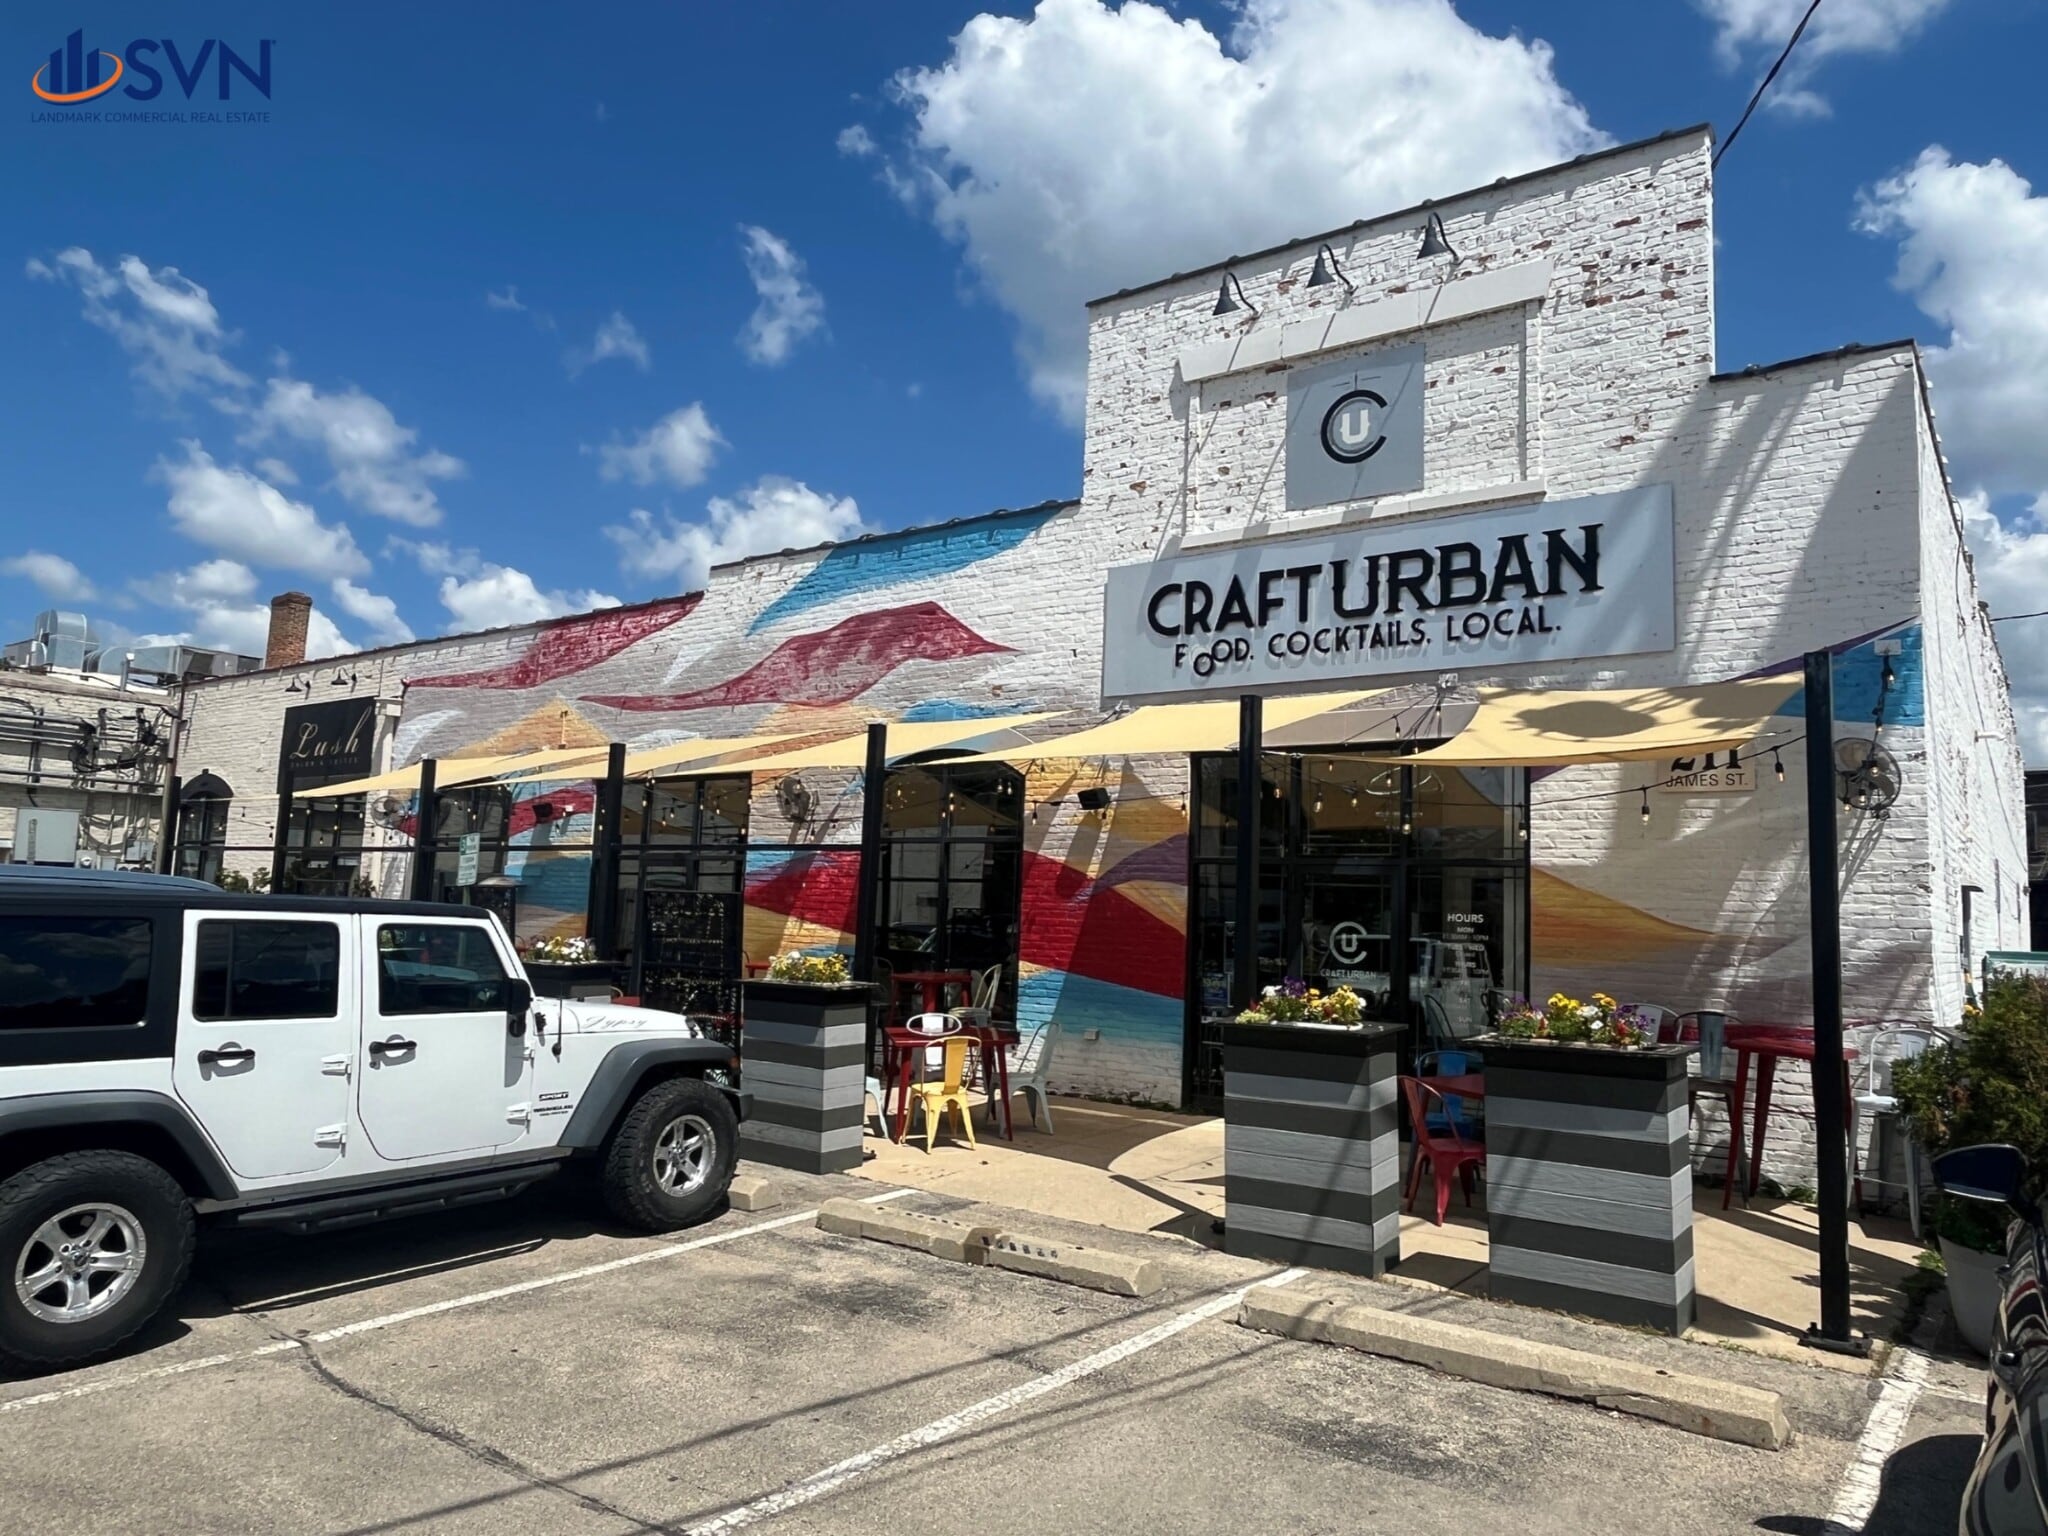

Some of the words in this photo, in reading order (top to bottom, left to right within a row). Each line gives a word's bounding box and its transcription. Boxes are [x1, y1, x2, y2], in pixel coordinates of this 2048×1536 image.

[1174, 637, 1255, 677] FOOD.
[1268, 617, 1432, 659] COCKTAILS.
[1447, 605, 1562, 642] LOCAL.
[290, 706, 372, 760] Lush
[1666, 773, 1718, 787] JAMES
[1726, 773, 1749, 786] ST.
[1447, 913, 1484, 923] HOURS
